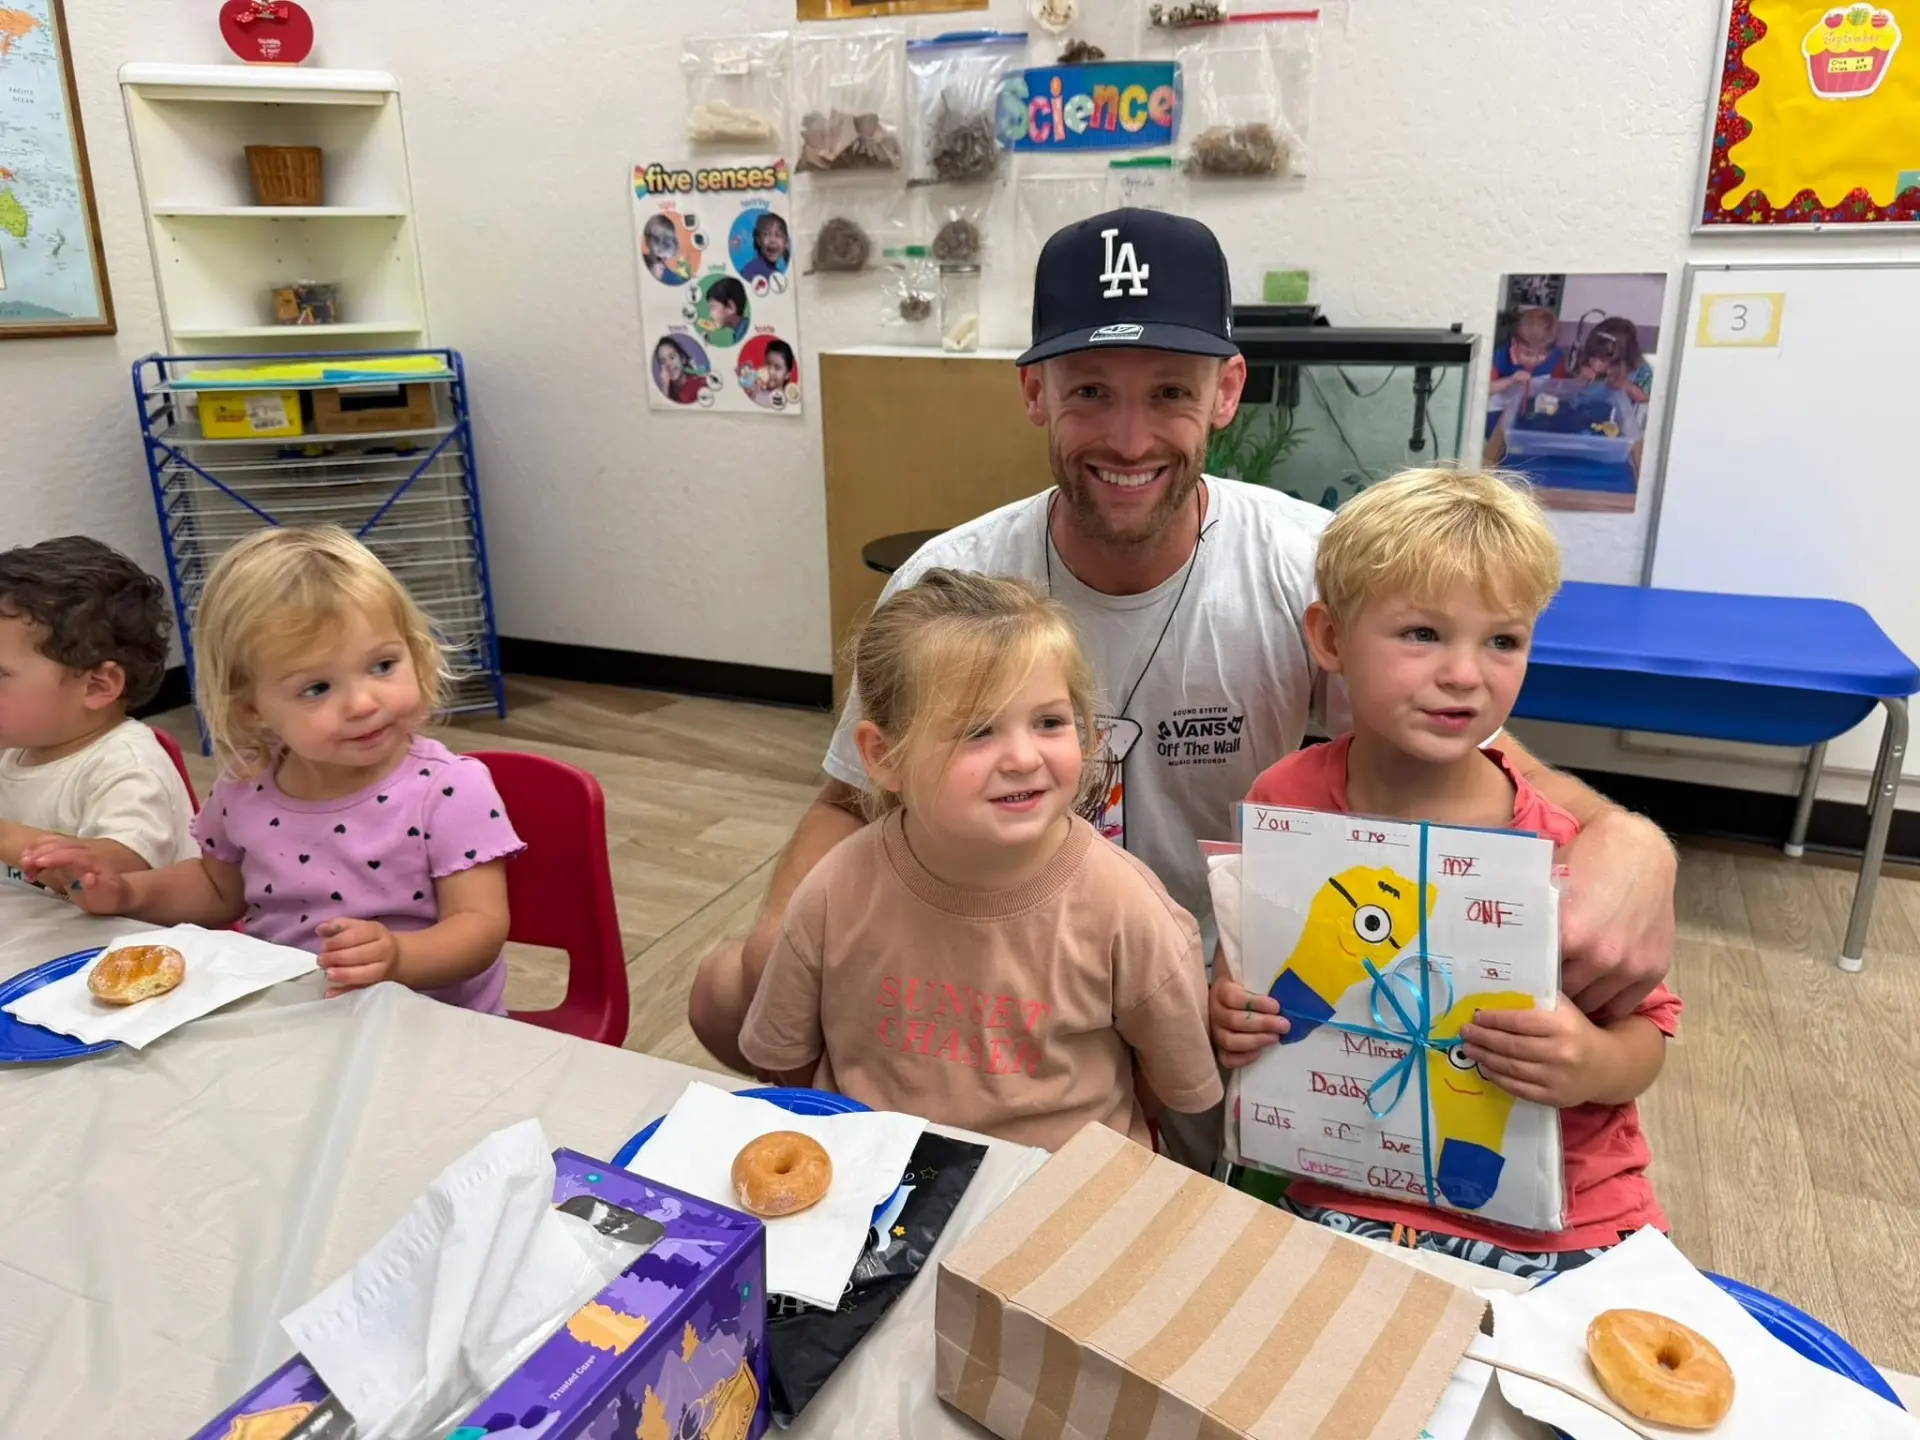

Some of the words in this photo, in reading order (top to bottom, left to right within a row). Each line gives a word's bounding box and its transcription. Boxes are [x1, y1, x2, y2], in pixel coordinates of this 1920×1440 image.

[1002, 76, 1177, 144] Science
[645, 163, 693, 194] five
[697, 167, 777, 192] senses
[1099, 228, 1150, 299] LA
[1730, 304, 1748, 331] 3
[1173, 708, 1197, 716] SOUND
[1199, 706, 1228, 714] SYSTEM
[1172, 716, 1228, 738] VANS
[1157, 741, 1181, 757] Off
[1183, 740, 1210, 756] The
[1213, 737, 1241, 755] Wall
[1168, 759, 1191, 767] MUSIC
[1193, 757, 1227, 765] RECORDS
[1256, 809, 1291, 831] You
[877, 975, 1051, 1034] SUNSET
[878, 1014, 1043, 1076] CHASER
[549, 1372, 579, 1401] Trusted
